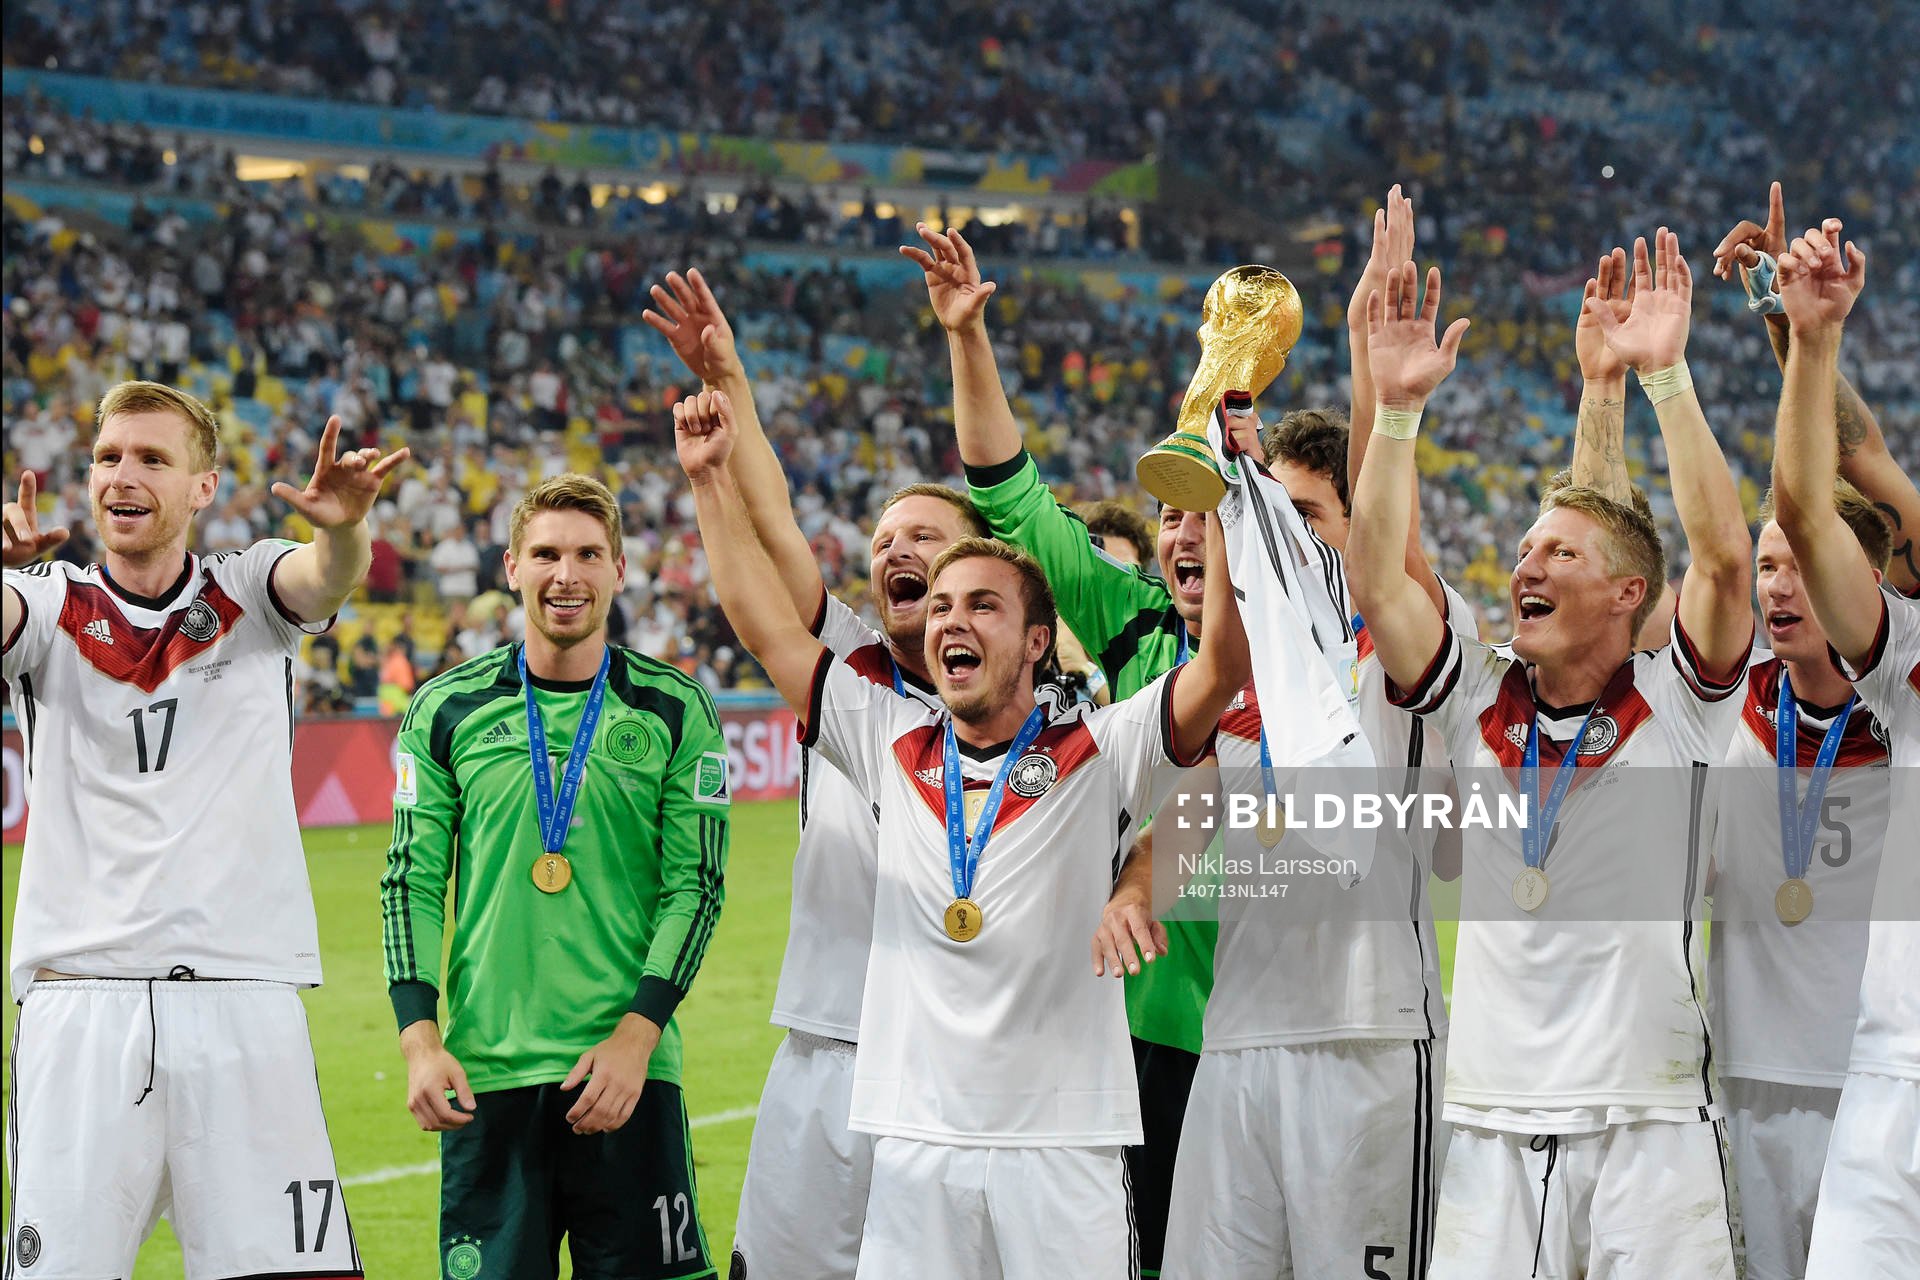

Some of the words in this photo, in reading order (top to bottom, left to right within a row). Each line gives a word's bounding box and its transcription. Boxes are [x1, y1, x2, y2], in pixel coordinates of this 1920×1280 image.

[81, 626, 115, 645] adidas
[126, 698, 178, 773] 17
[482, 735, 517, 743] adidas
[914, 770, 943, 789] adidas
[285, 1180, 334, 1253] 17
[652, 1192, 697, 1264] 12
